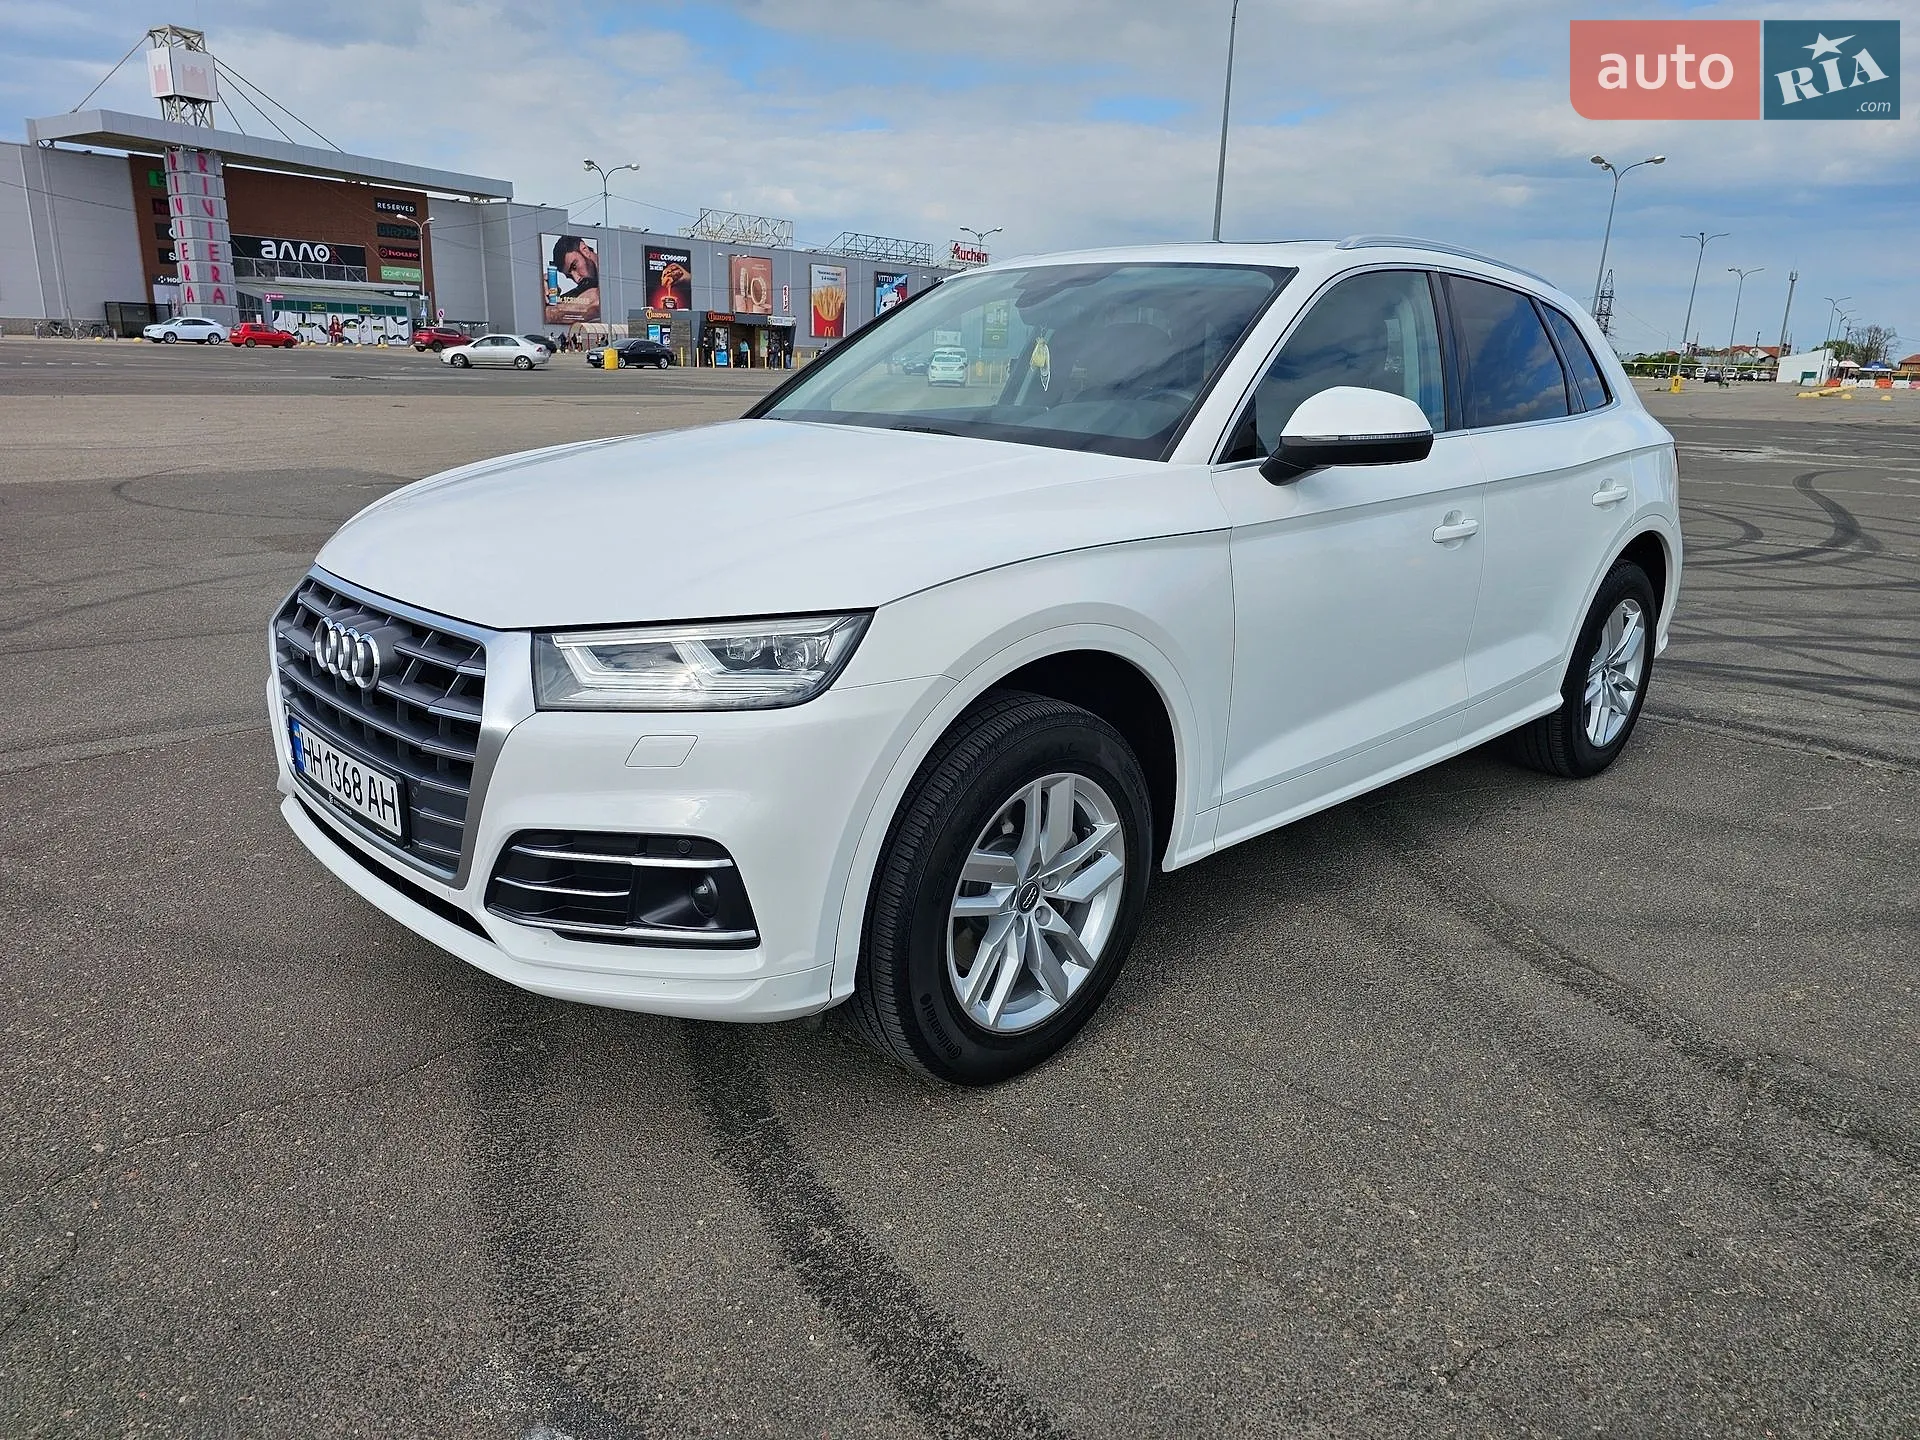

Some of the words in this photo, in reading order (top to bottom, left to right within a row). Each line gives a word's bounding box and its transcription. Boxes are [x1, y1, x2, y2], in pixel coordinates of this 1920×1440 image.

[169, 152, 195, 303] RIVIERA
[197, 152, 226, 304] RIVIERA
[377, 202, 415, 213] RESERVED
[951, 242, 988, 264] Auchan
[325, 750, 363, 806] 1368
[368, 775, 398, 827] AH
